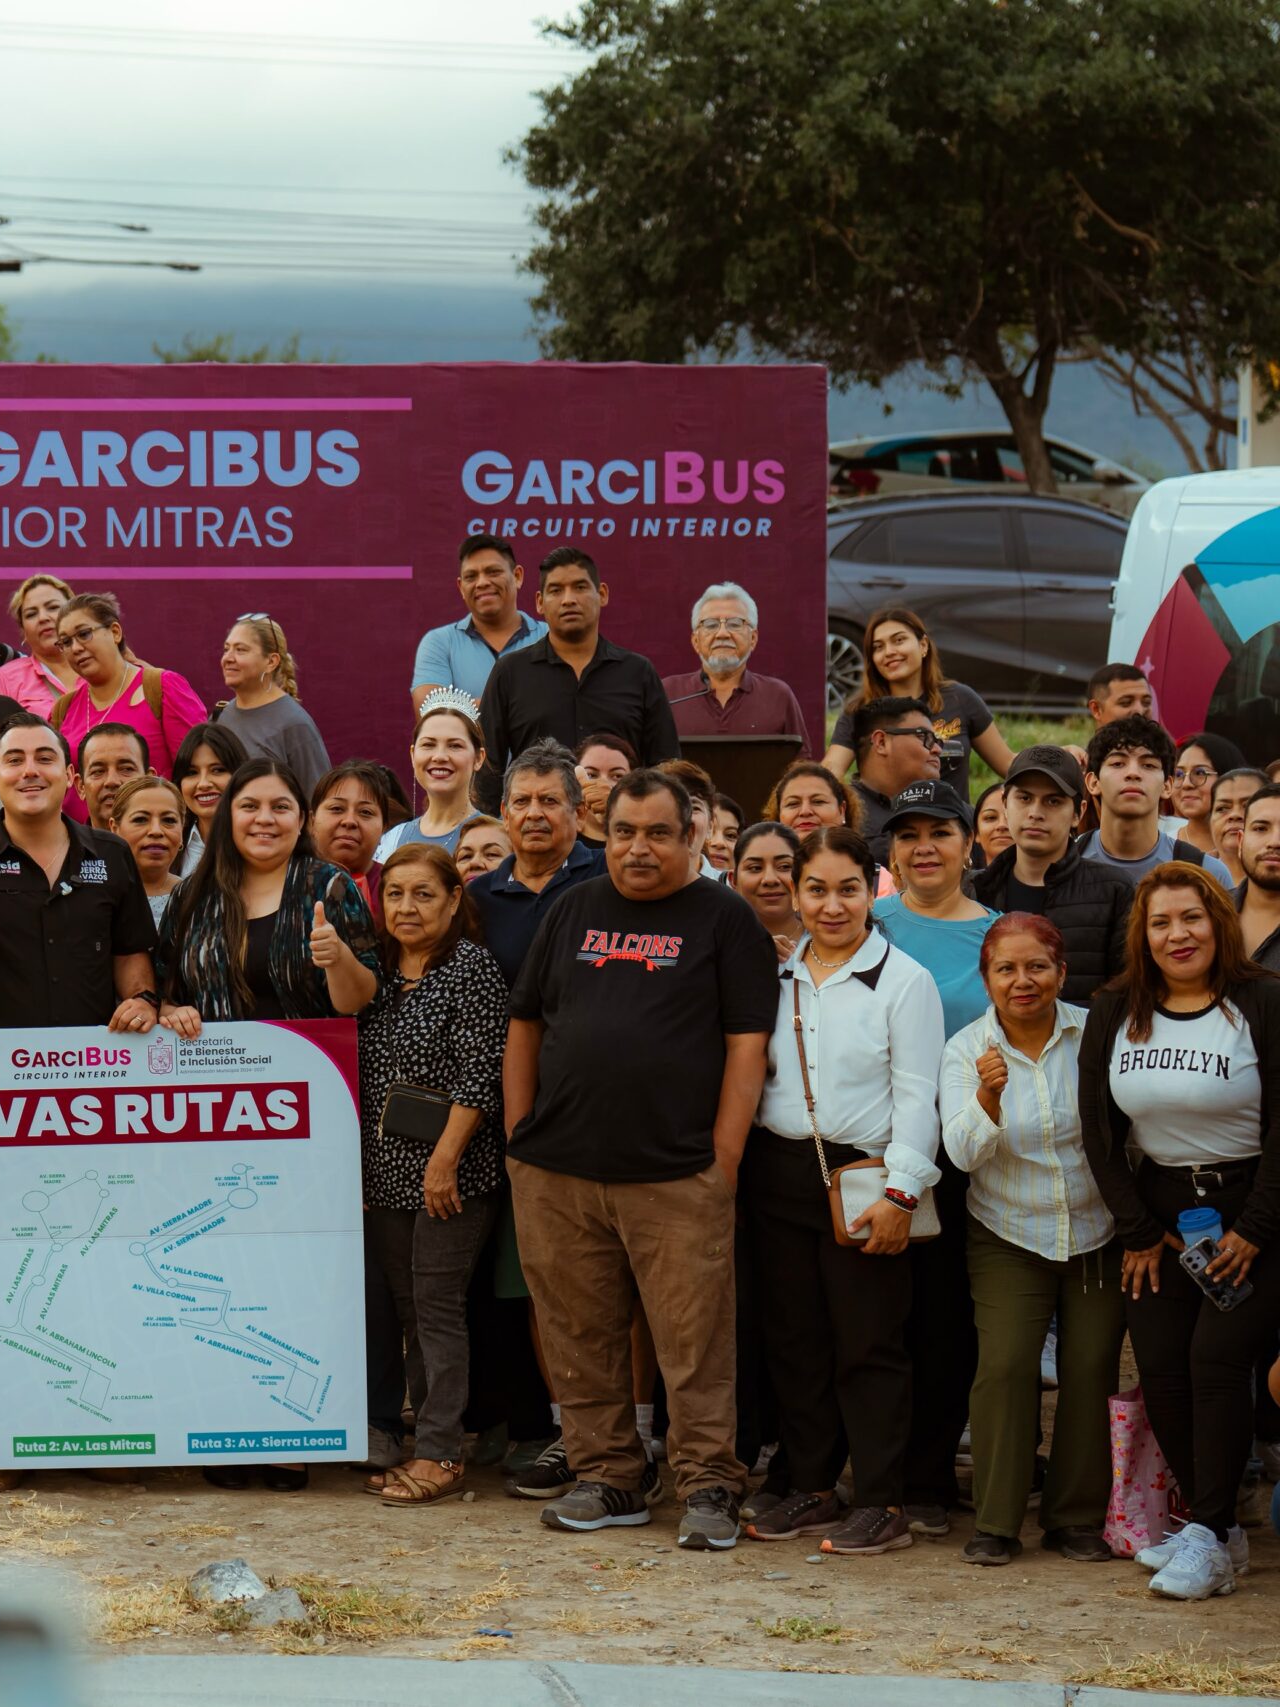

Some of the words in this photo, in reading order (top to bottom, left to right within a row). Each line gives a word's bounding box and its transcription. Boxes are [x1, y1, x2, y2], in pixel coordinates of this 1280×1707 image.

[461, 450, 785, 505] GARCIBUS
[106, 506, 293, 548] MITRAS
[467, 518, 616, 537] CIRCUITO
[630, 518, 772, 537] INTERIOR
[581, 929, 682, 958] FALCONS
[180, 1036, 232, 1047] Secretaría
[180, 1048, 193, 1056] de
[195, 1047, 246, 1056] Bienestar
[14, 1071, 69, 1080] CIRCUITO
[74, 1070, 127, 1079] INTERIOR
[180, 1059, 186, 1067] e
[188, 1056, 237, 1066] Inclusión
[240, 1055, 272, 1065] Social
[1119, 1048, 1231, 1080] BROOKLYN
[114, 1089, 299, 1136] RUTAS
[80, 1244, 91, 1257] AV.
[89, 1231, 100, 1245] LAS
[98, 1207, 118, 1232] MITRAS
[149, 1226, 163, 1237] AV.
[162, 1213, 187, 1229] SIERRA
[187, 1198, 213, 1216] MADRE
[163, 1244, 177, 1255] AV.
[175, 1231, 201, 1247] SIERRA
[200, 1216, 226, 1234] MADRE
[6, 1291, 15, 1304] AV.
[11, 1276, 22, 1290] LAS
[18, 1248, 34, 1277] MITRAS
[160, 1263, 172, 1272] AV.
[174, 1267, 192, 1276] VILLA
[193, 1271, 224, 1283] CORONA
[40, 1306, 49, 1320] AV.
[45, 1292, 56, 1306] LAS
[52, 1263, 68, 1292] MITRAS
[132, 1283, 145, 1291] AV.
[146, 1286, 165, 1296] VILLA
[166, 1291, 196, 1303] CORONA
[3, 1337, 41, 1359] ABRAHAM
[40, 1353, 73, 1373] LINCOLN
[36, 1324, 48, 1335] AV.
[48, 1331, 86, 1354] ABRAHAM
[86, 1349, 117, 1369] LINCOLN
[194, 1334, 207, 1344] AV.
[207, 1339, 243, 1356] ABRAHAM
[242, 1351, 272, 1367] LINCOLN
[246, 1324, 257, 1334] AV.
[258, 1331, 292, 1352] ABRAHAM
[292, 1347, 320, 1366] LINCOLN
[16, 1442, 47, 1453] Ruta
[49, 1441, 60, 1452] 2:
[62, 1441, 83, 1452] Av.
[86, 1440, 107, 1451] Las
[110, 1439, 152, 1451] Mitras
[192, 1439, 221, 1449] Ruta
[224, 1438, 236, 1448] 3:
[238, 1437, 260, 1448] Av.
[262, 1437, 301, 1448] Sierra
[304, 1436, 343, 1447] Leona
